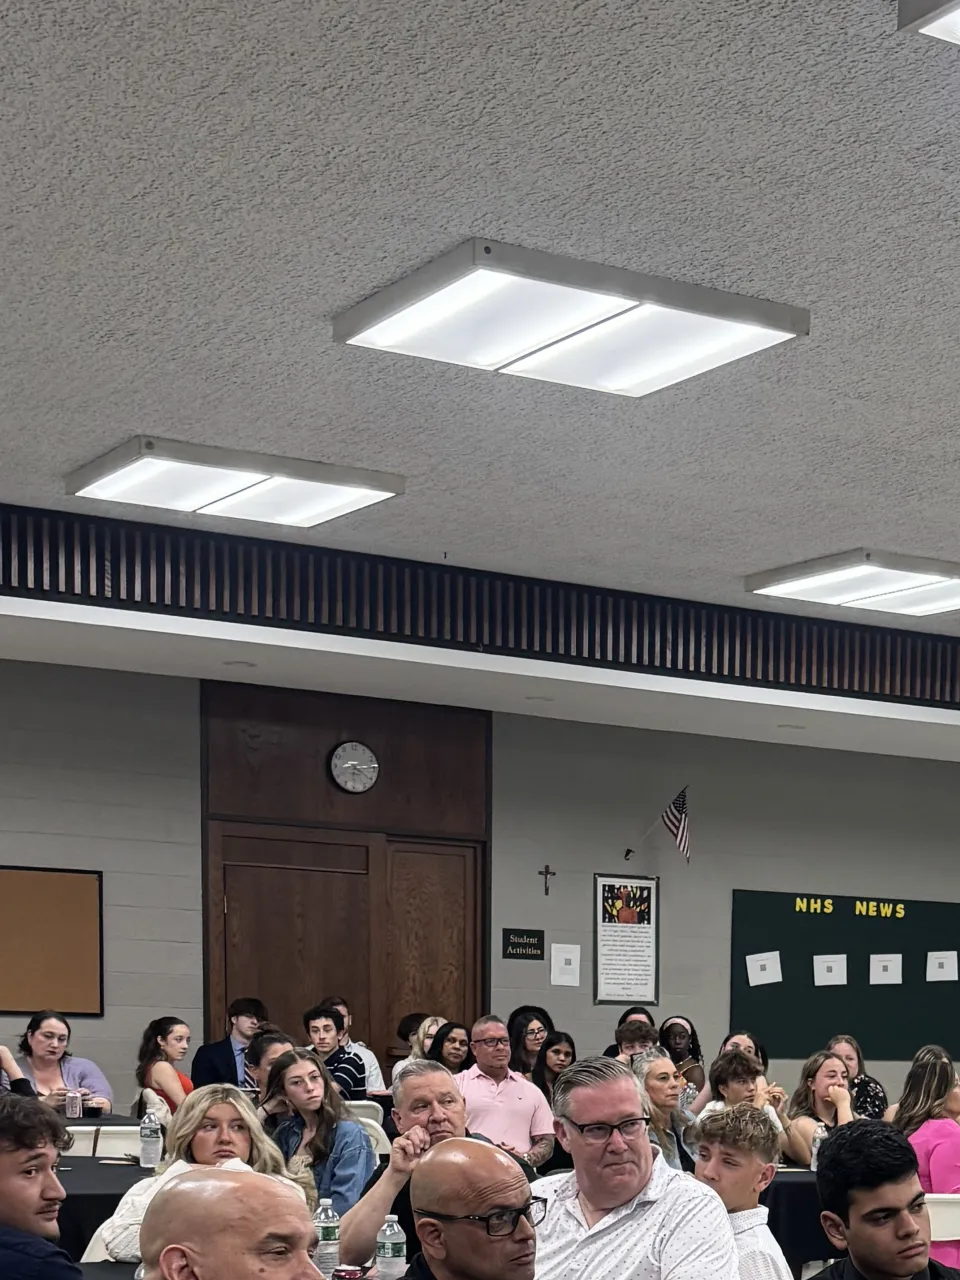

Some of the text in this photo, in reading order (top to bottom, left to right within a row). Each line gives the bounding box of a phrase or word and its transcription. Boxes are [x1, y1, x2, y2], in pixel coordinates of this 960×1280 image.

[795, 897, 906, 918] NHS NEWS
[510, 934, 538, 945] Student
[506, 945, 541, 955] Activities
